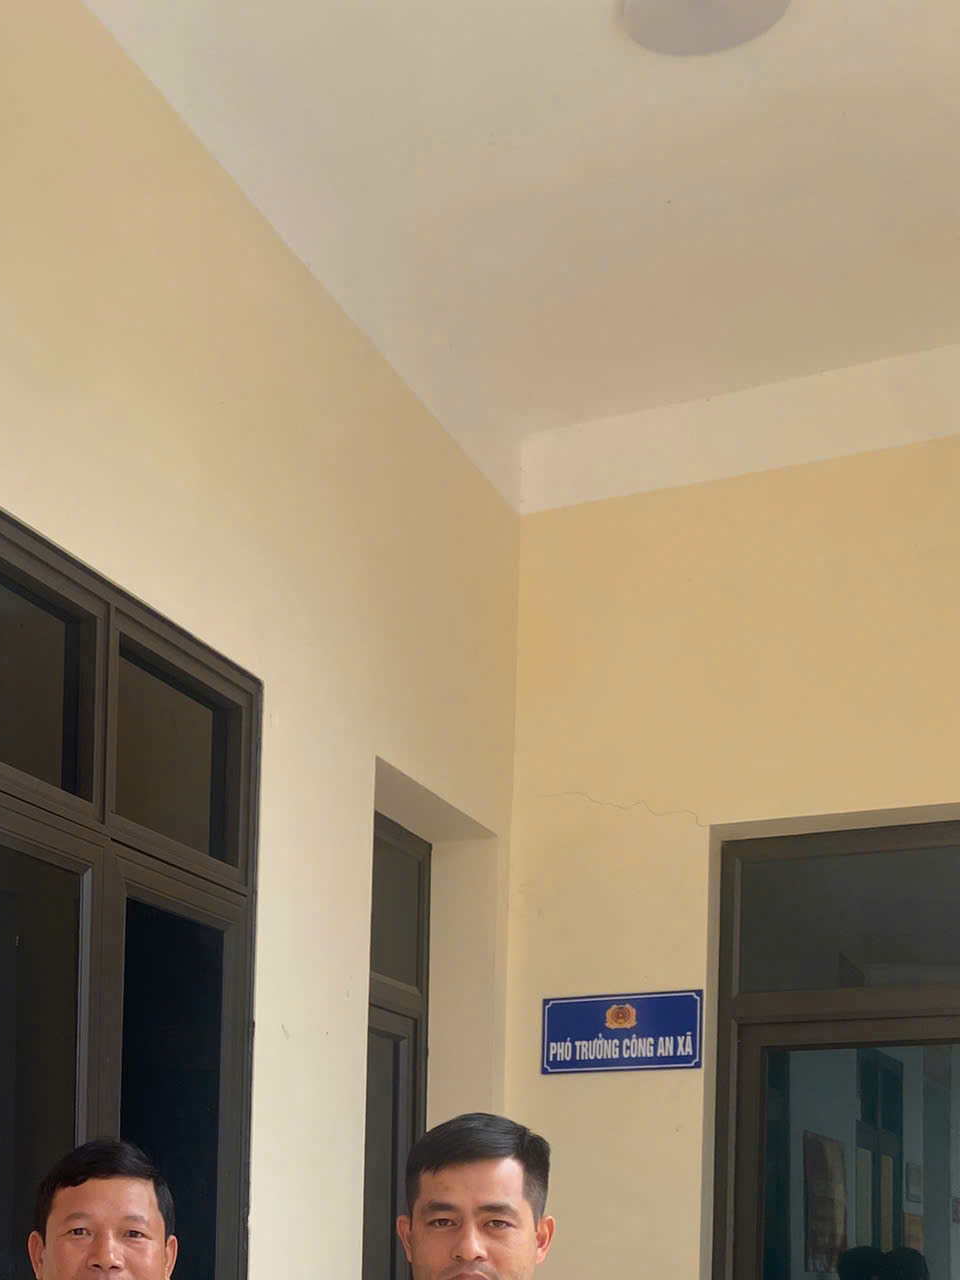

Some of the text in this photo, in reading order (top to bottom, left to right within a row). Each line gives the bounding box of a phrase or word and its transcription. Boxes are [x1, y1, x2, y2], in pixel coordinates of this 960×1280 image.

[549, 1032, 693, 1061] PHÓ TRƯỞNG CÔNG AN XÃ
